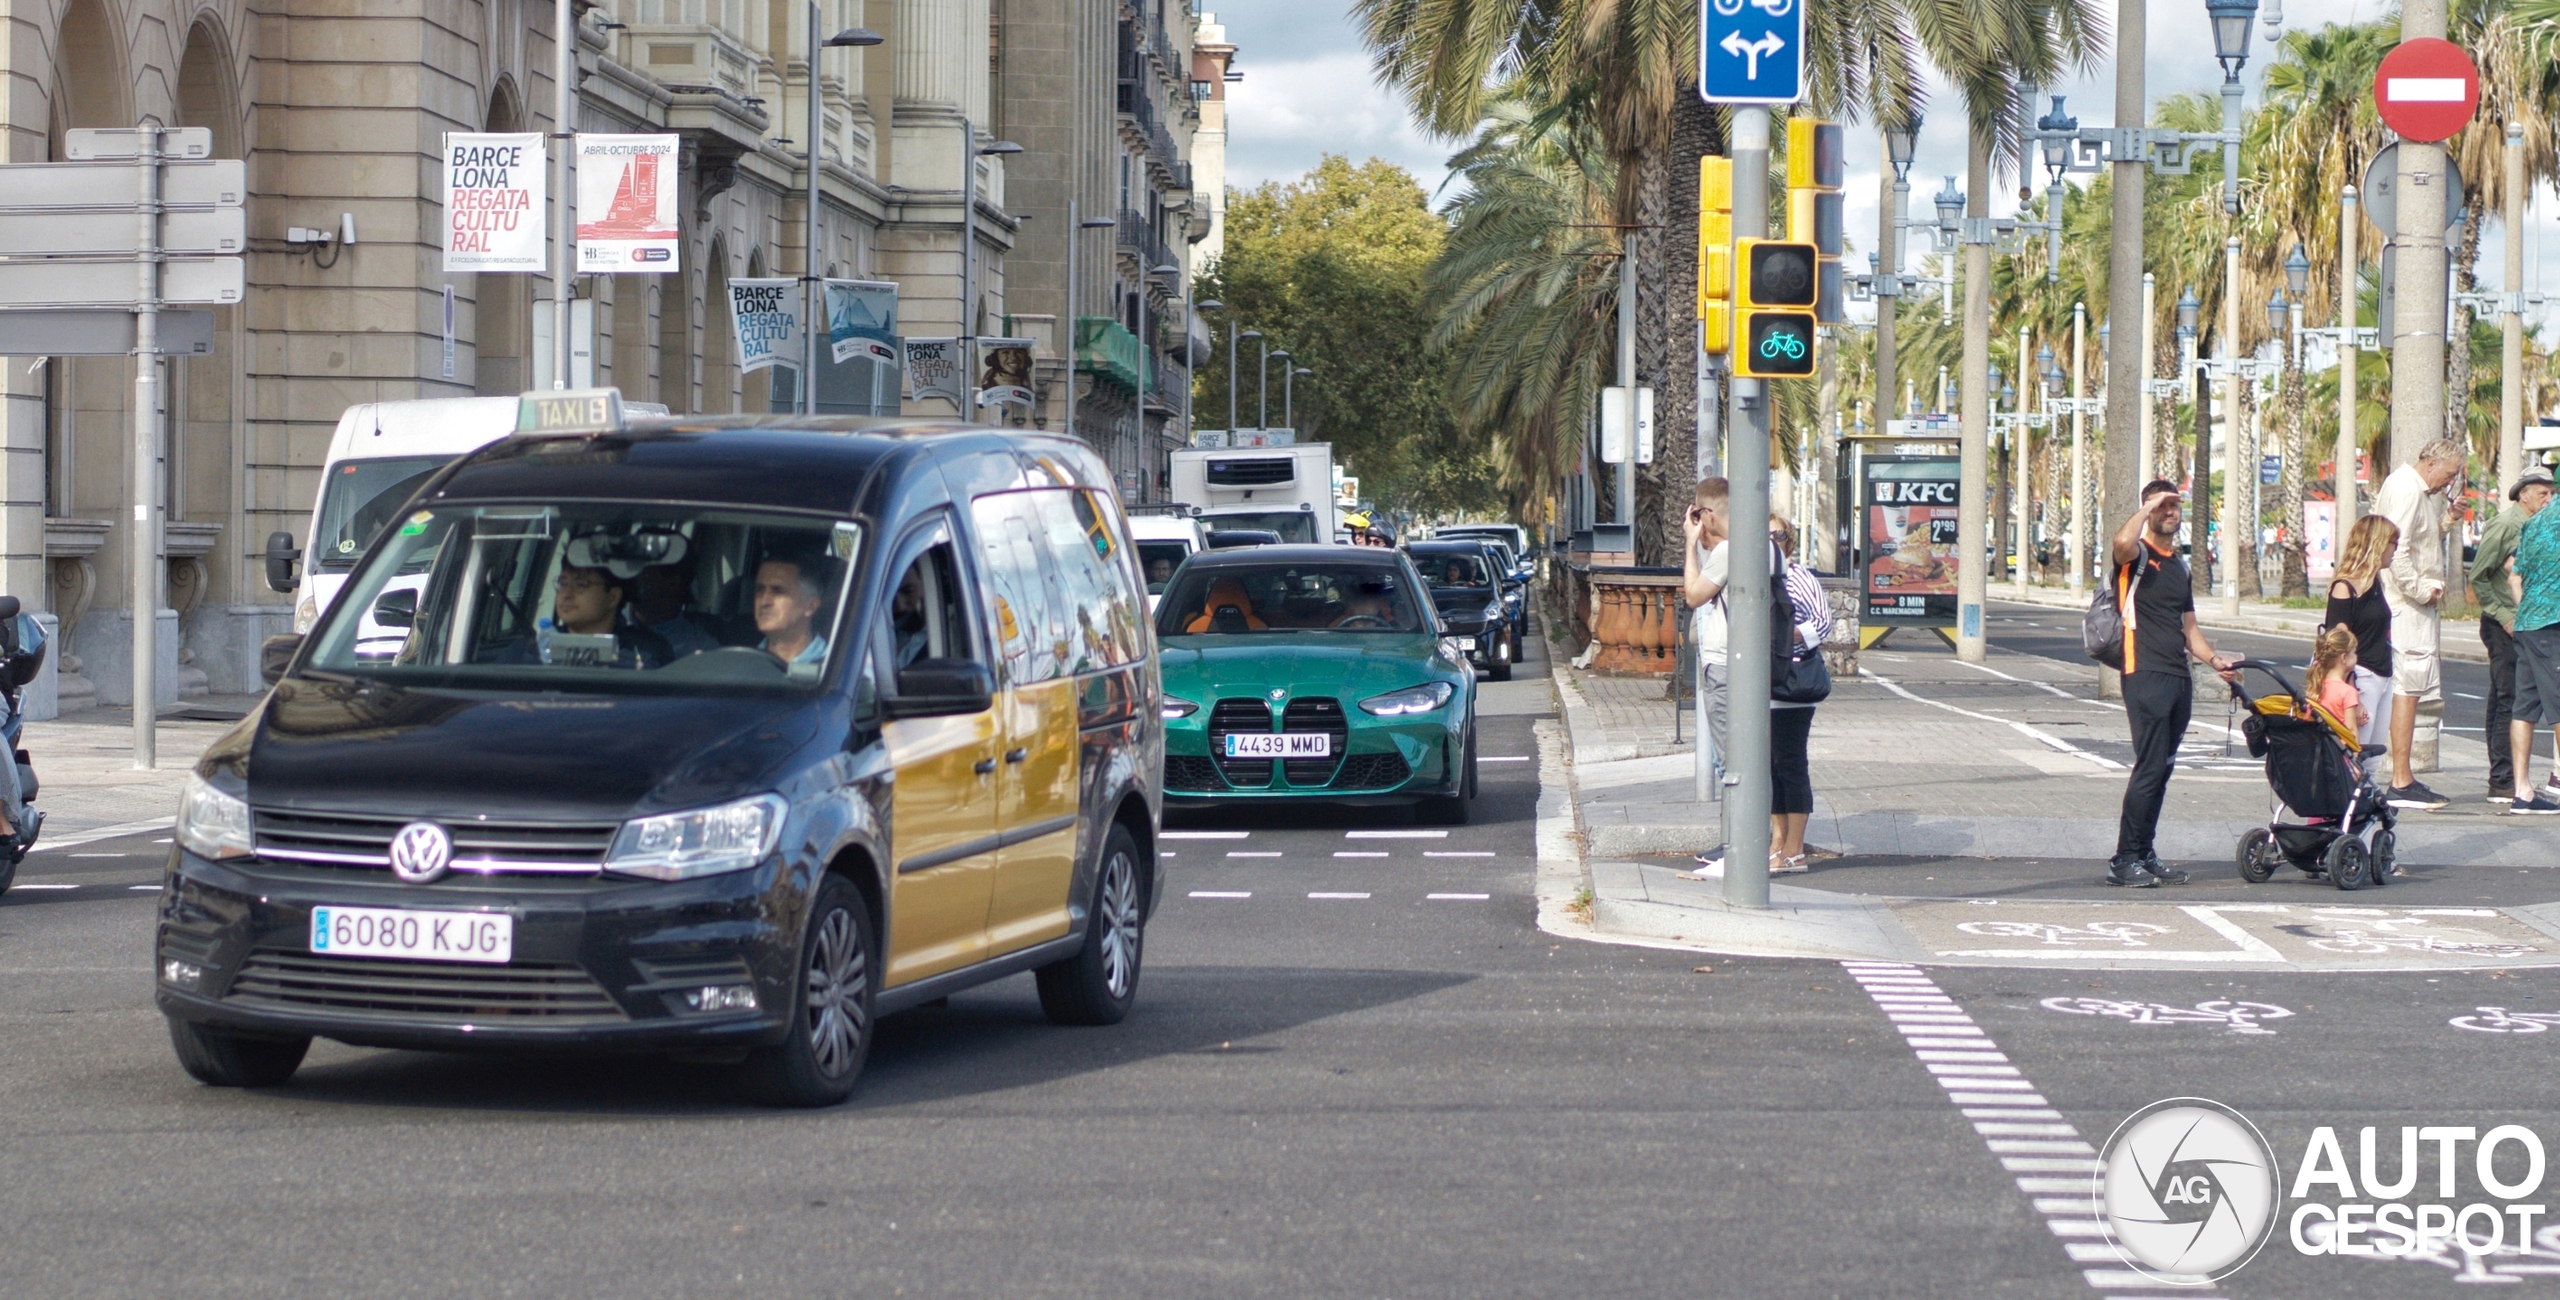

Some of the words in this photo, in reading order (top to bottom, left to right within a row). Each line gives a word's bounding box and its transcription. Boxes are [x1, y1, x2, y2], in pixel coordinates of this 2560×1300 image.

[452, 146, 522, 167] BARCE
[584, 145, 648, 154] ABRIL-OCTUBRE
[650, 145, 670, 154] 2024
[452, 168, 508, 188] LONA
[452, 189, 530, 210] REGATA
[452, 210, 519, 231] CULTU
[451, 232, 492, 252] RAL
[734, 287, 784, 300] BARCE
[736, 300, 778, 315] LONA
[739, 312, 794, 330] REGATA
[741, 326, 788, 344] CULTU
[744, 340, 772, 359] RAL
[906, 343, 946, 352] BARCE
[908, 350, 941, 362] LONA
[910, 360, 954, 372] REGATA
[912, 369, 949, 379] CULTU
[914, 378, 936, 392] RAL
[538, 400, 584, 428] TAXI
[1897, 482, 1955, 502] KFC
[1932, 520, 1955, 542] 2'99
[1899, 596, 1906, 607] 8
[1907, 596, 1925, 607] MIN
[1239, 736, 1284, 754] 4439
[1290, 736, 1325, 752] MMD
[335, 914, 418, 948] 6080
[433, 918, 497, 953] KJG
